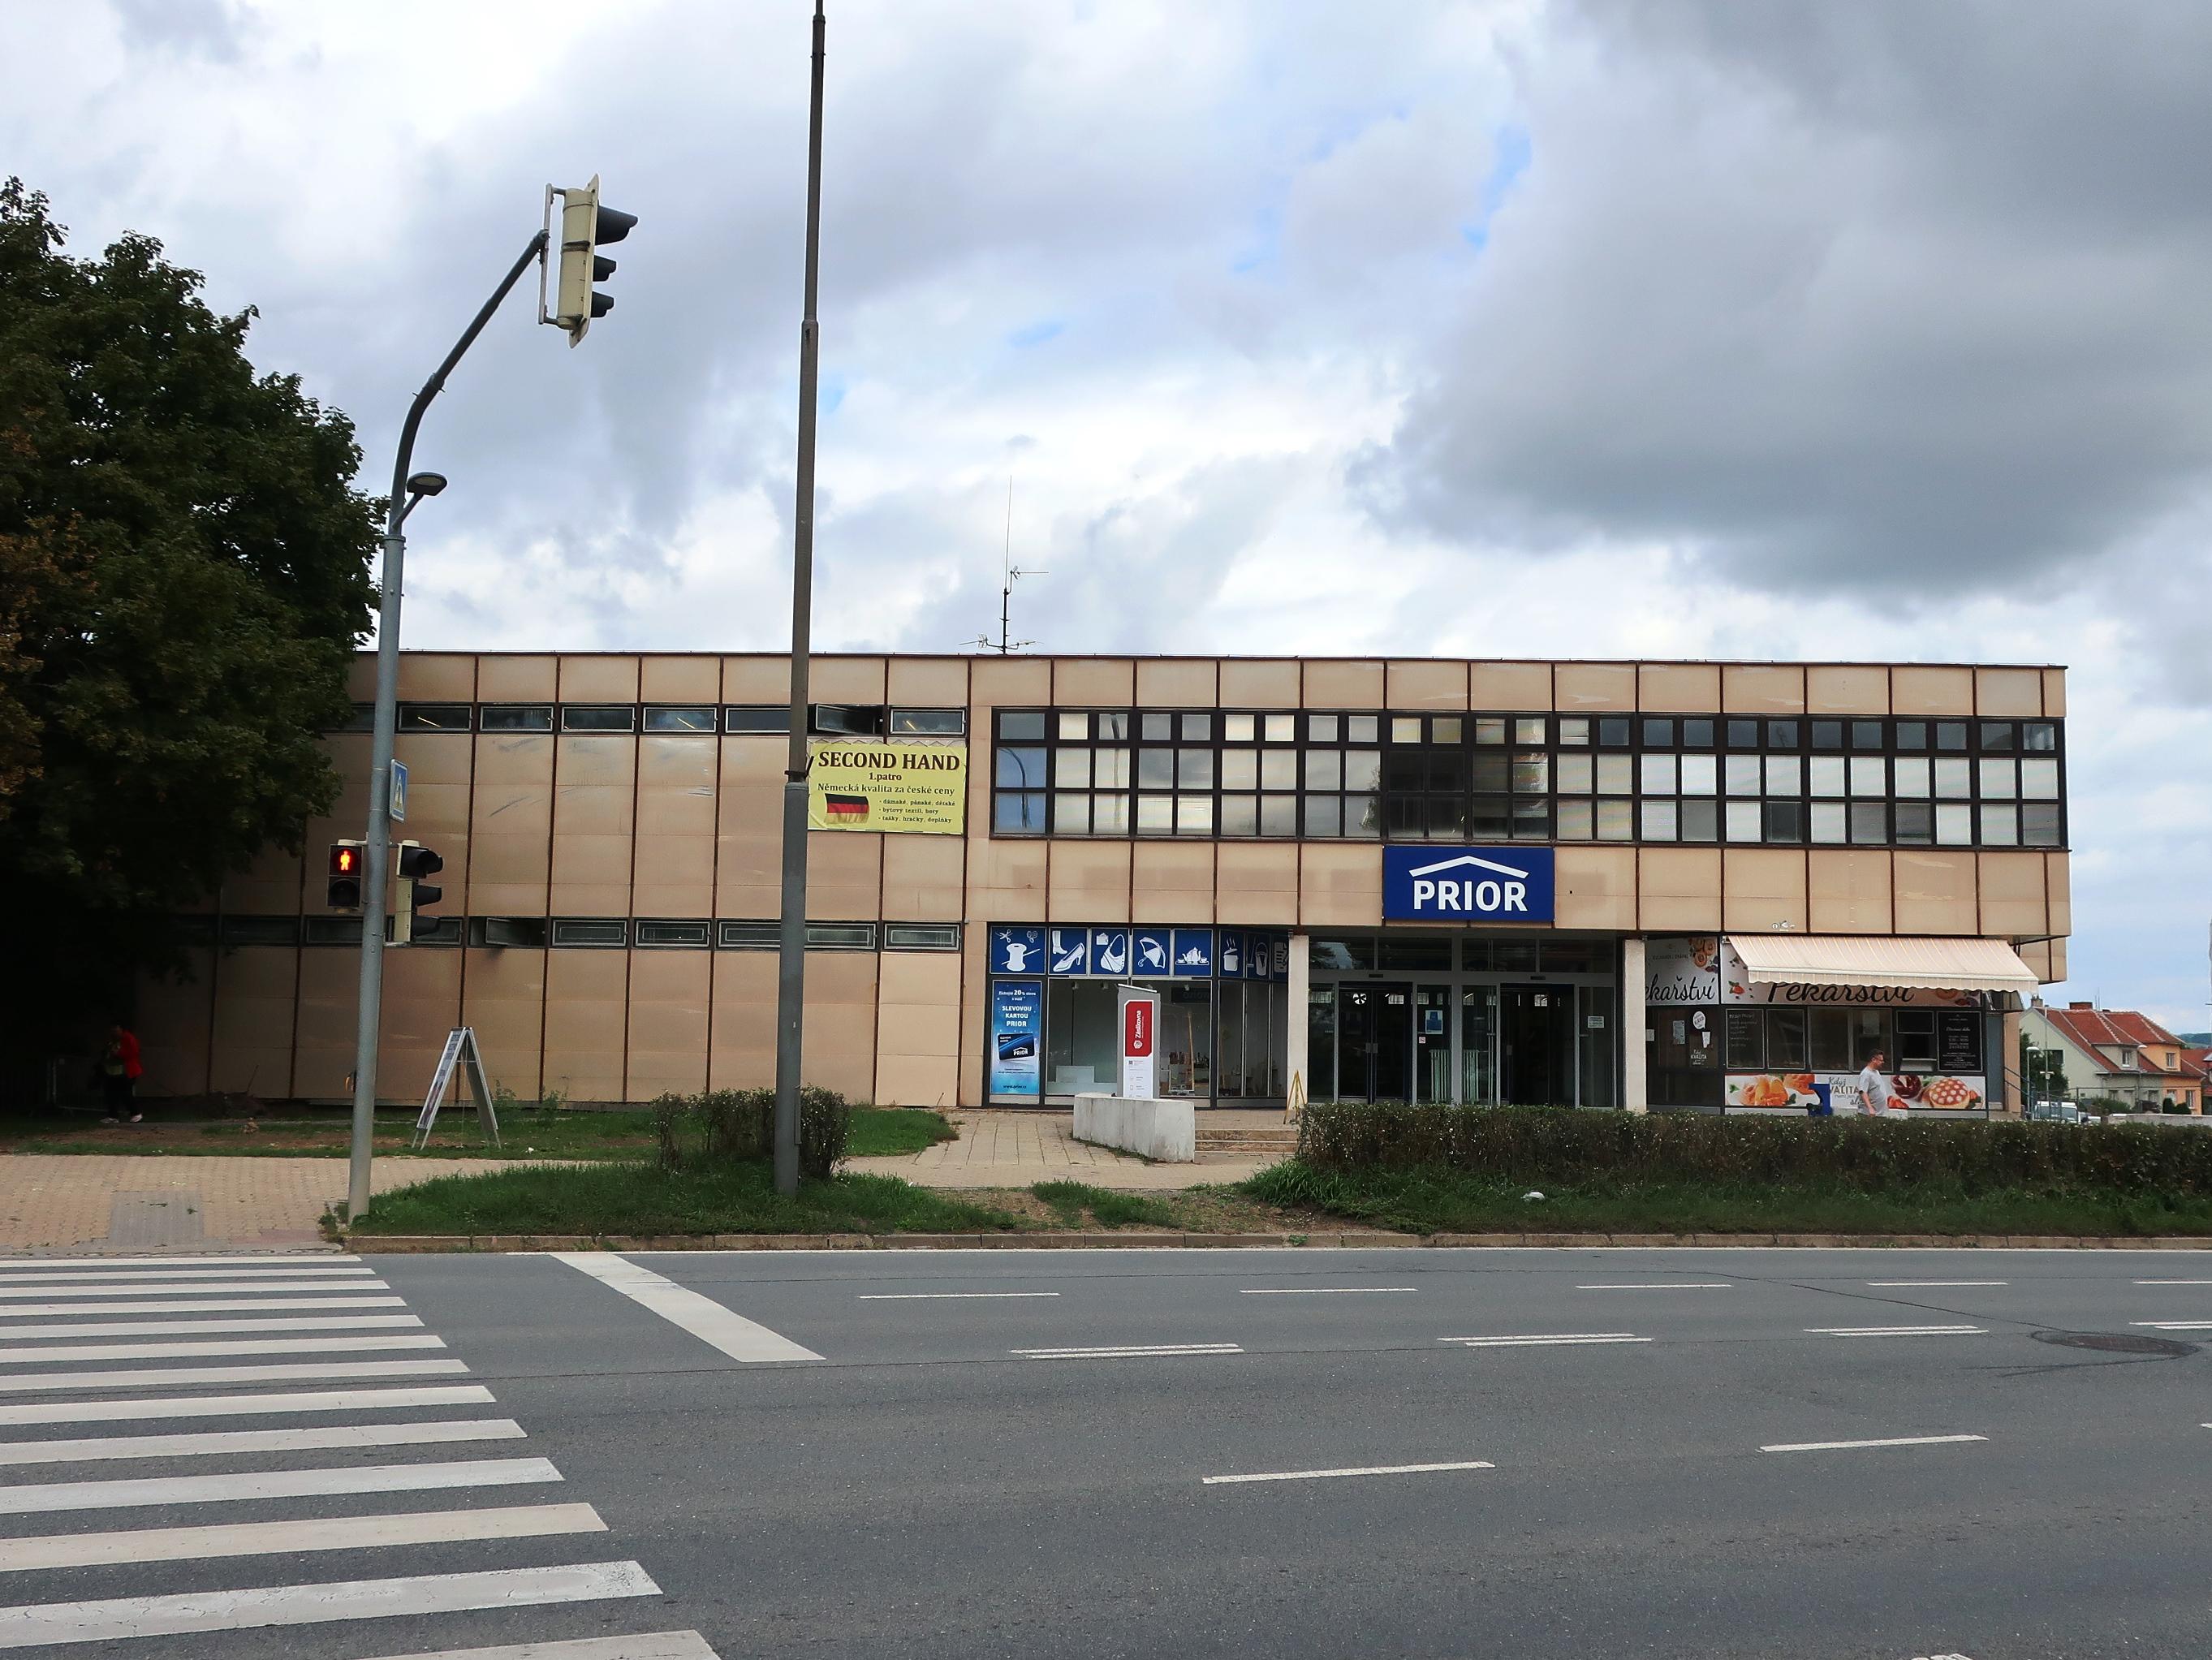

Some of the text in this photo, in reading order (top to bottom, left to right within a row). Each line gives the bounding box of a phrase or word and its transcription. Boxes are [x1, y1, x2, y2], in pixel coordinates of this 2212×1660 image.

[817, 752, 960, 770] SECOND HAND
[869, 772, 903, 782] 1.patro
[817, 783, 860, 792] Německá
[861, 784, 893, 794] kvalita
[907, 784, 933, 795] české
[934, 787, 955, 797] ceny
[1413, 880, 1528, 912] PRIOR
[1645, 973, 1715, 1001] ekařství
